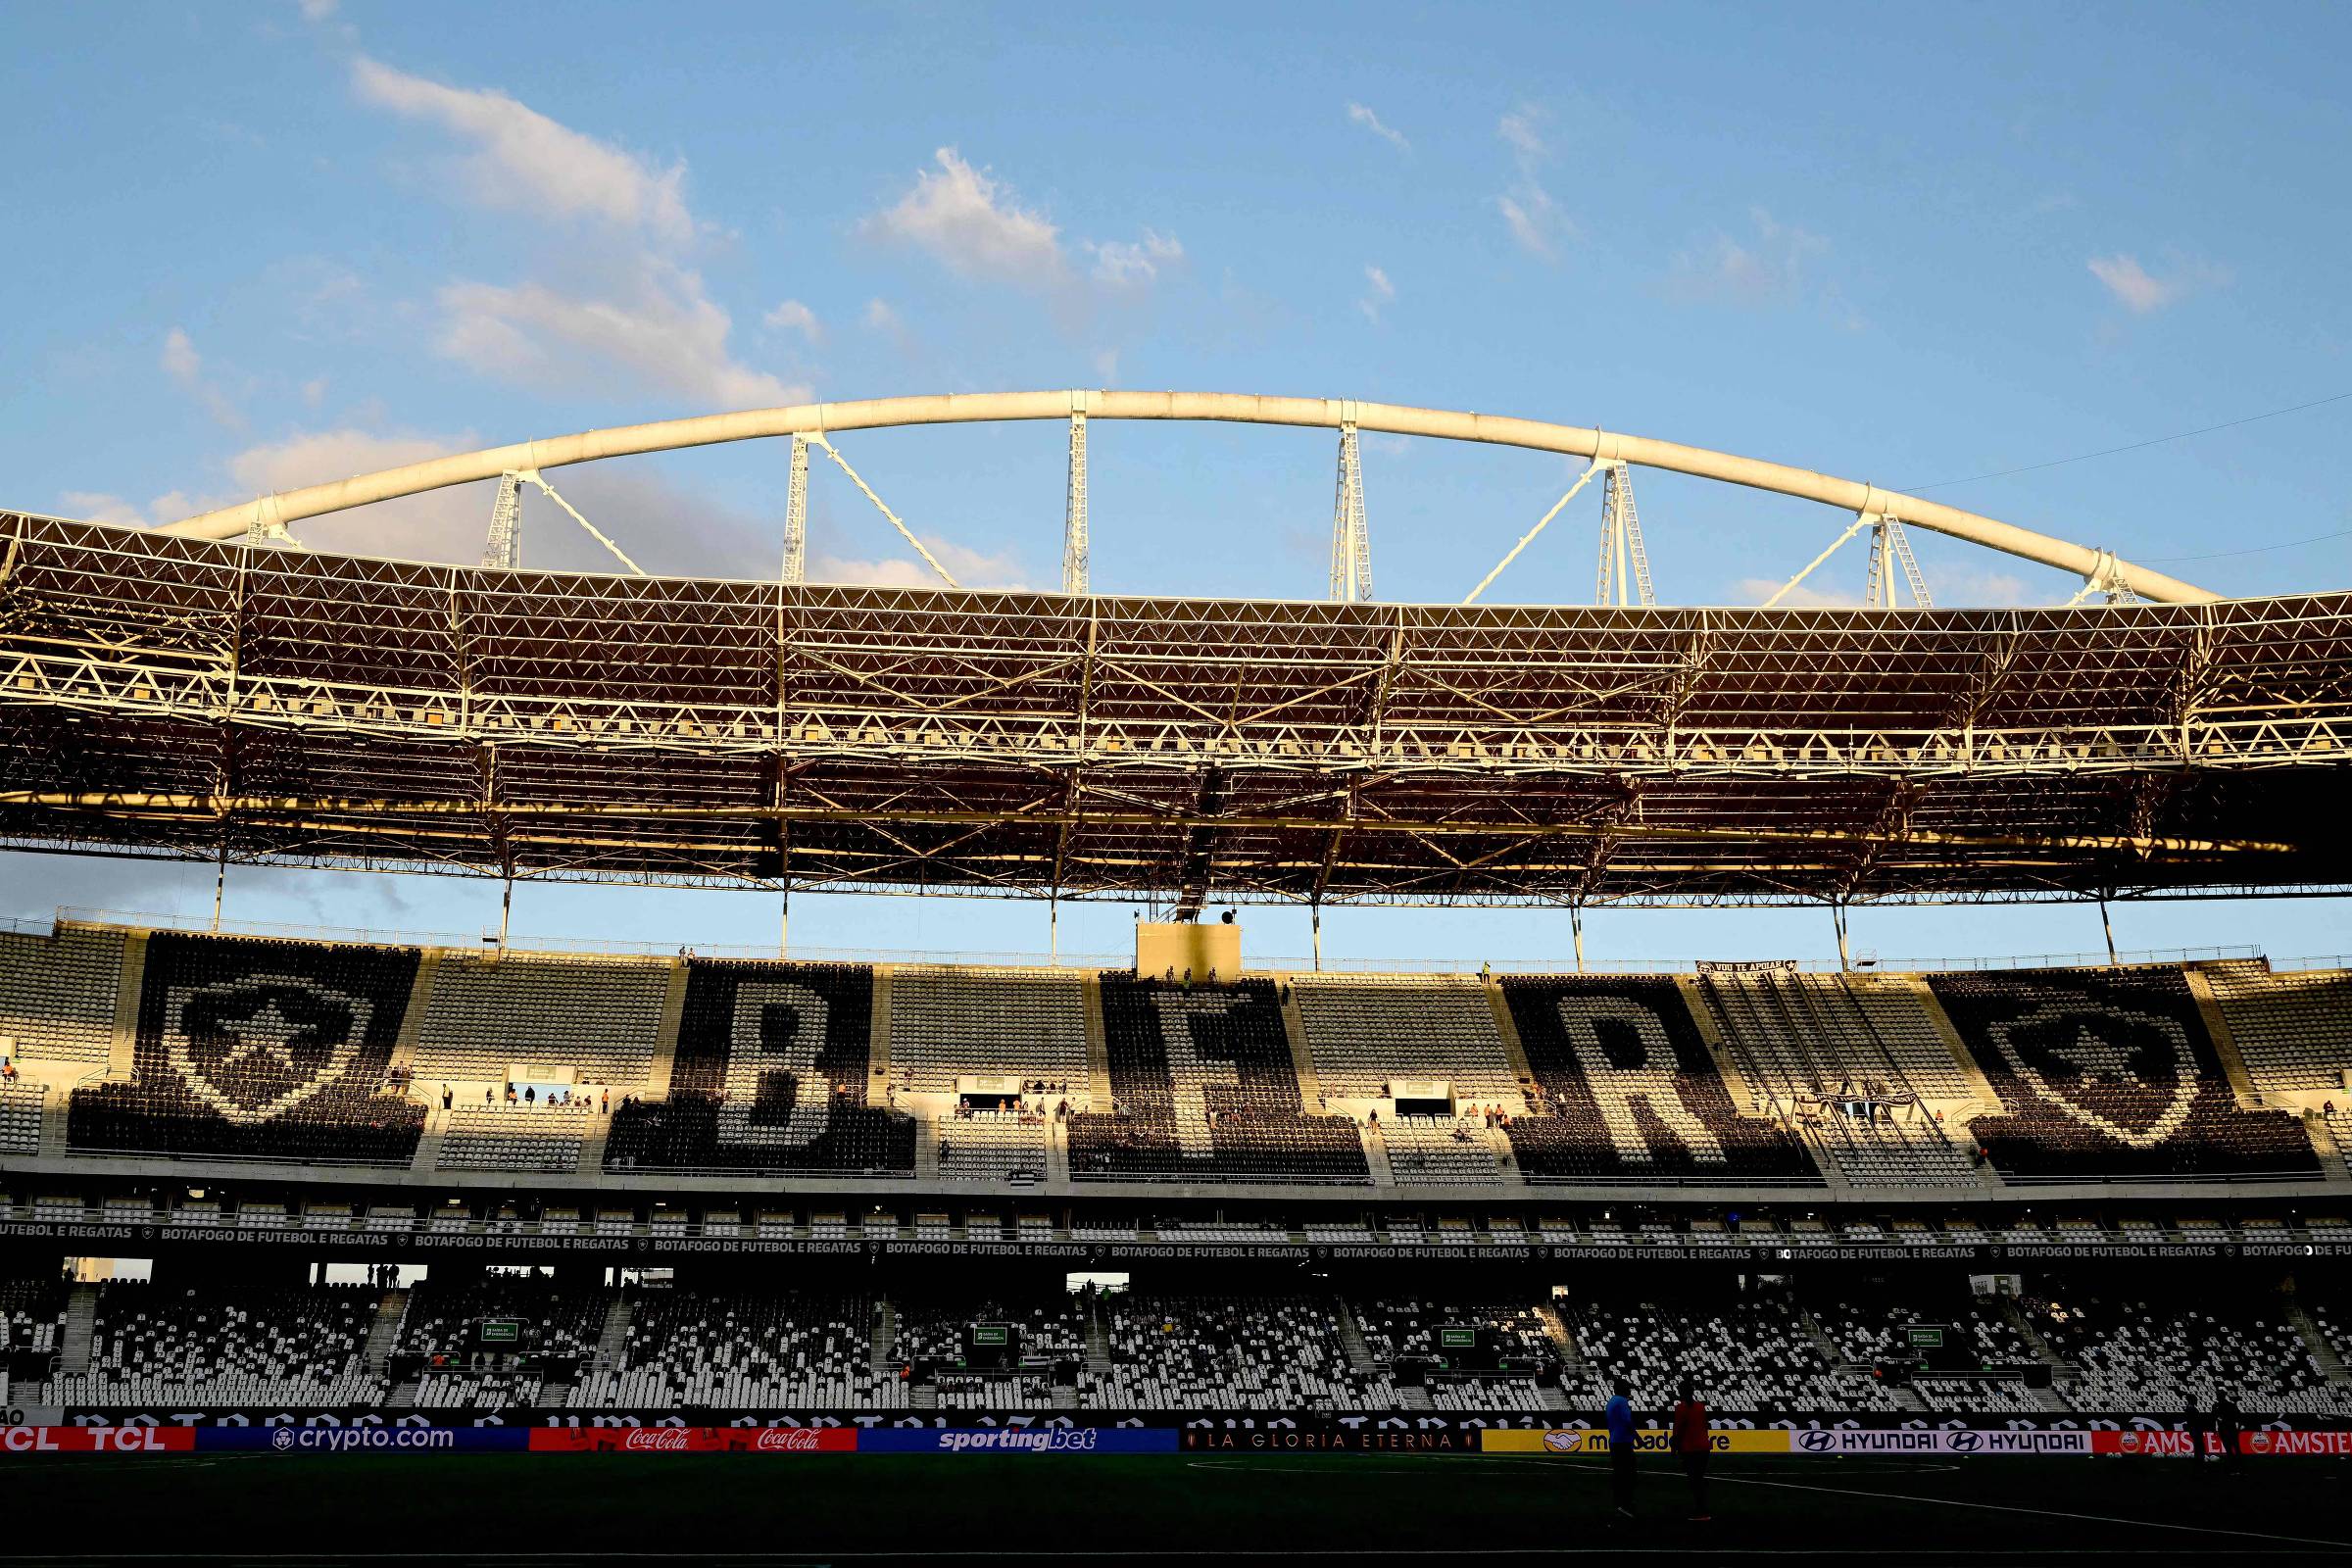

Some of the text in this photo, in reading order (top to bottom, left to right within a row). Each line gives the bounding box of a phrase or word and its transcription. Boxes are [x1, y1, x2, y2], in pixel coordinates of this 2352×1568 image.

[1749, 960, 1782, 971] APOIAR
[0, 1223, 132, 1239] UTEBOL E REGATAS
[162, 1228, 388, 1245] BOTAFOGO DE FUTEBOL E REGATAS
[416, 1235, 628, 1250] BOTAFOGO DE FUTEBOL E REGATAS
[655, 1240, 860, 1254] BOTAFOGO DE FUTEBOL E REGATAS
[886, 1243, 1087, 1256] BOTAFOGO DE FUTEBOL E REGATAS
[1111, 1246, 1309, 1257] BOTAFOGO DE FUTEBOL E REGATAS
[1334, 1247, 1530, 1258] BOTAFOGO DE FUTEBOL E REGATAS
[1554, 1248, 1751, 1258] BOTAFOGO DE FUTEBOL E REGATAS
[1776, 1247, 1975, 1258] BOTAFOGO DE FUTEBOL E REGATAS
[2008, 1246, 2216, 1257] BOTAFOGO DE FUTEBOL E REGATAS
[2243, 1245, 2313, 1256] BOTAFOGO
[2316, 1245, 2332, 1255] DE
[0, 1427, 59, 1449] CL
[87, 1427, 165, 1449] TCL
[299, 1427, 455, 1450] crypto.com
[939, 1428, 1098, 1450] sportingbet
[1208, 1434, 1451, 1448] LA GLORIA ETERNA
[1842, 1433, 1937, 1448] HYUNDAI
[1989, 1434, 2083, 1449] HYUNDAI
[2144, 1432, 2228, 1453] AMSE
[2276, 1432, 2352, 1453] AMSTE
